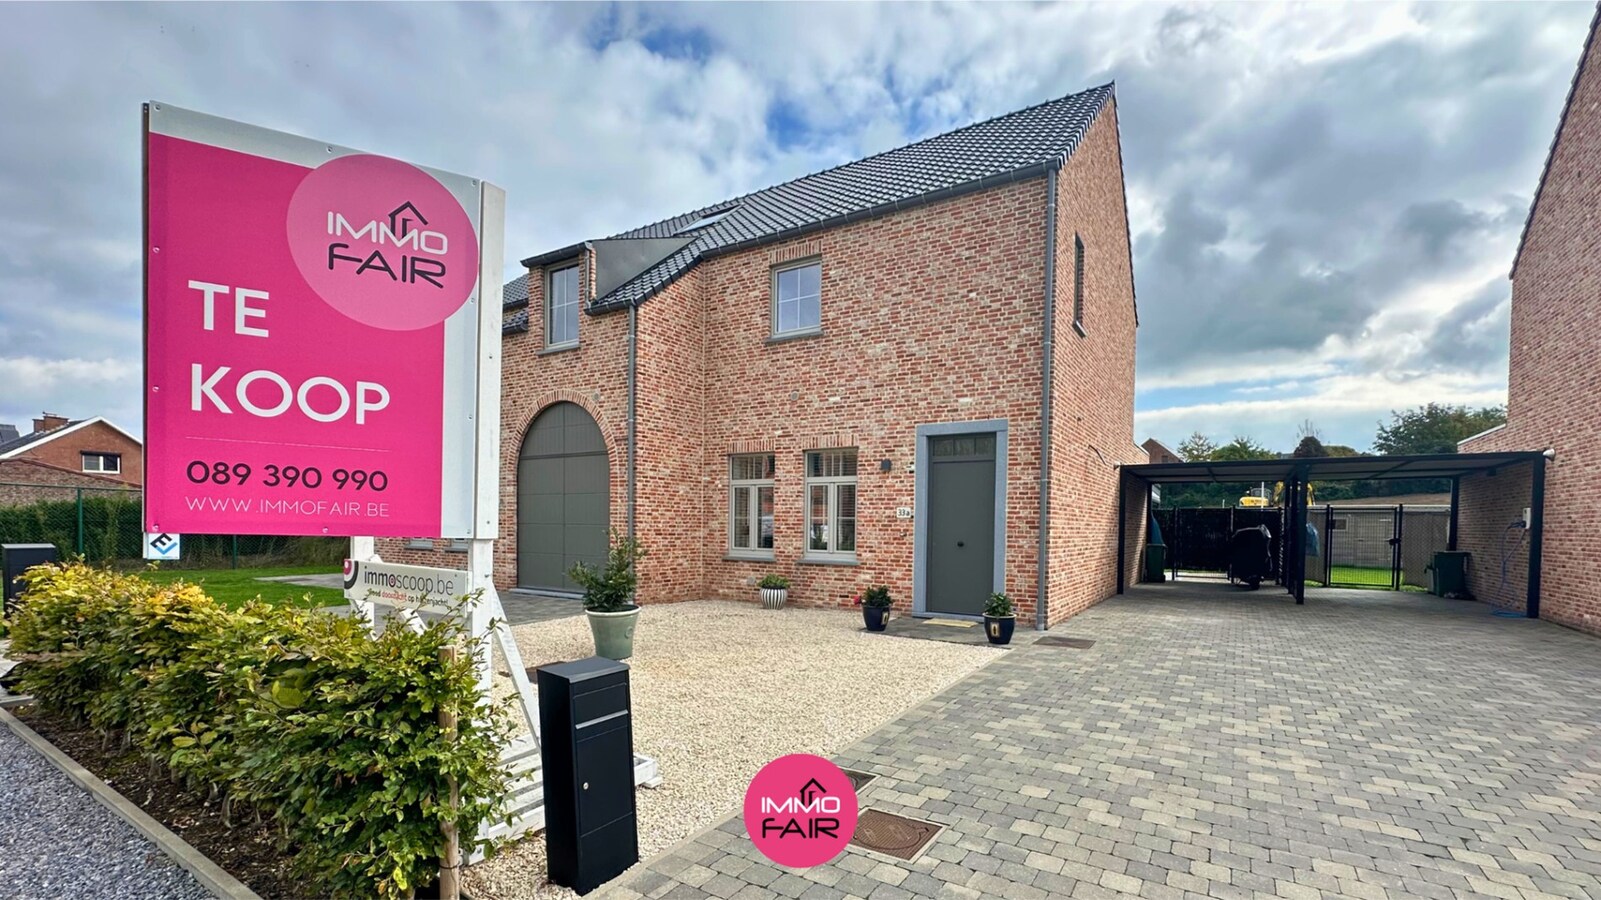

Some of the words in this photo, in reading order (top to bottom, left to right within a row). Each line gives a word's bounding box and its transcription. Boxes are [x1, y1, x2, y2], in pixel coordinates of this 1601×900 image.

[327, 211, 448, 255] IMMO
[327, 243, 447, 289] FAIR
[188, 280, 270, 338] TE
[191, 363, 391, 425] KOOP
[186, 460, 251, 486] 089
[262, 464, 322, 489] 390
[332, 468, 389, 492] 990
[184, 496, 390, 518] WWW.IMMOFAIR.BE
[364, 566, 454, 596] immoscoop.be
